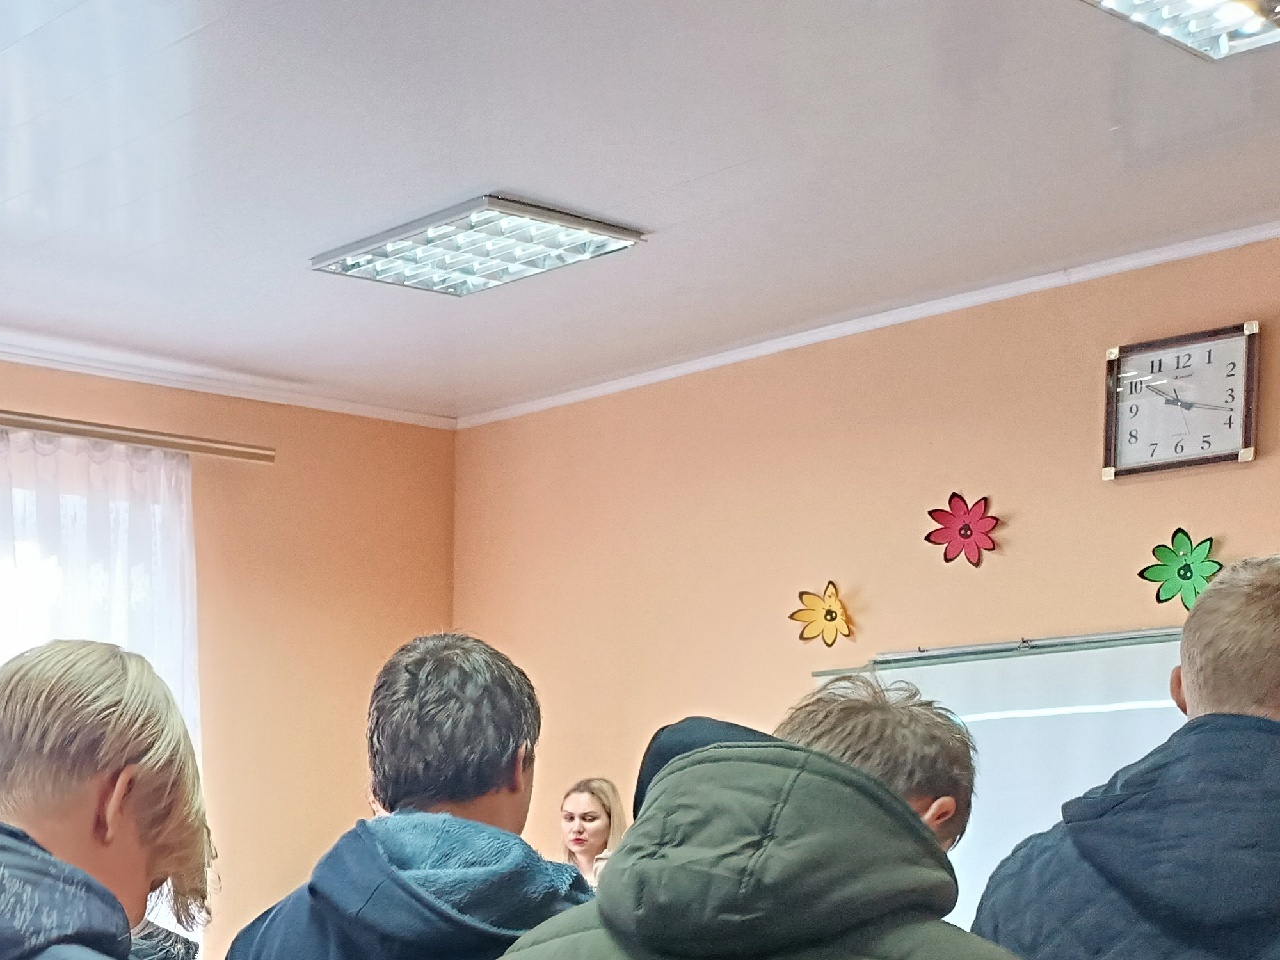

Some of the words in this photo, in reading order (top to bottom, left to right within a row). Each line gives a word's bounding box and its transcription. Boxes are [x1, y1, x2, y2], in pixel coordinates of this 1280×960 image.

[1174, 353, 1192, 371] 12
[1206, 349, 1213, 365] 1
[1149, 359, 1163, 374] 11
[1225, 362, 1237, 378] 2
[1128, 380, 1143, 396] 10
[1224, 388, 1235, 404] 3
[1129, 404, 1139, 419] 9
[1223, 414, 1234, 429] 4
[1128, 429, 1138, 444] 8
[1200, 435, 1211, 450] 5
[1149, 443, 1158, 458] 7
[1174, 439, 1184, 454] 6
